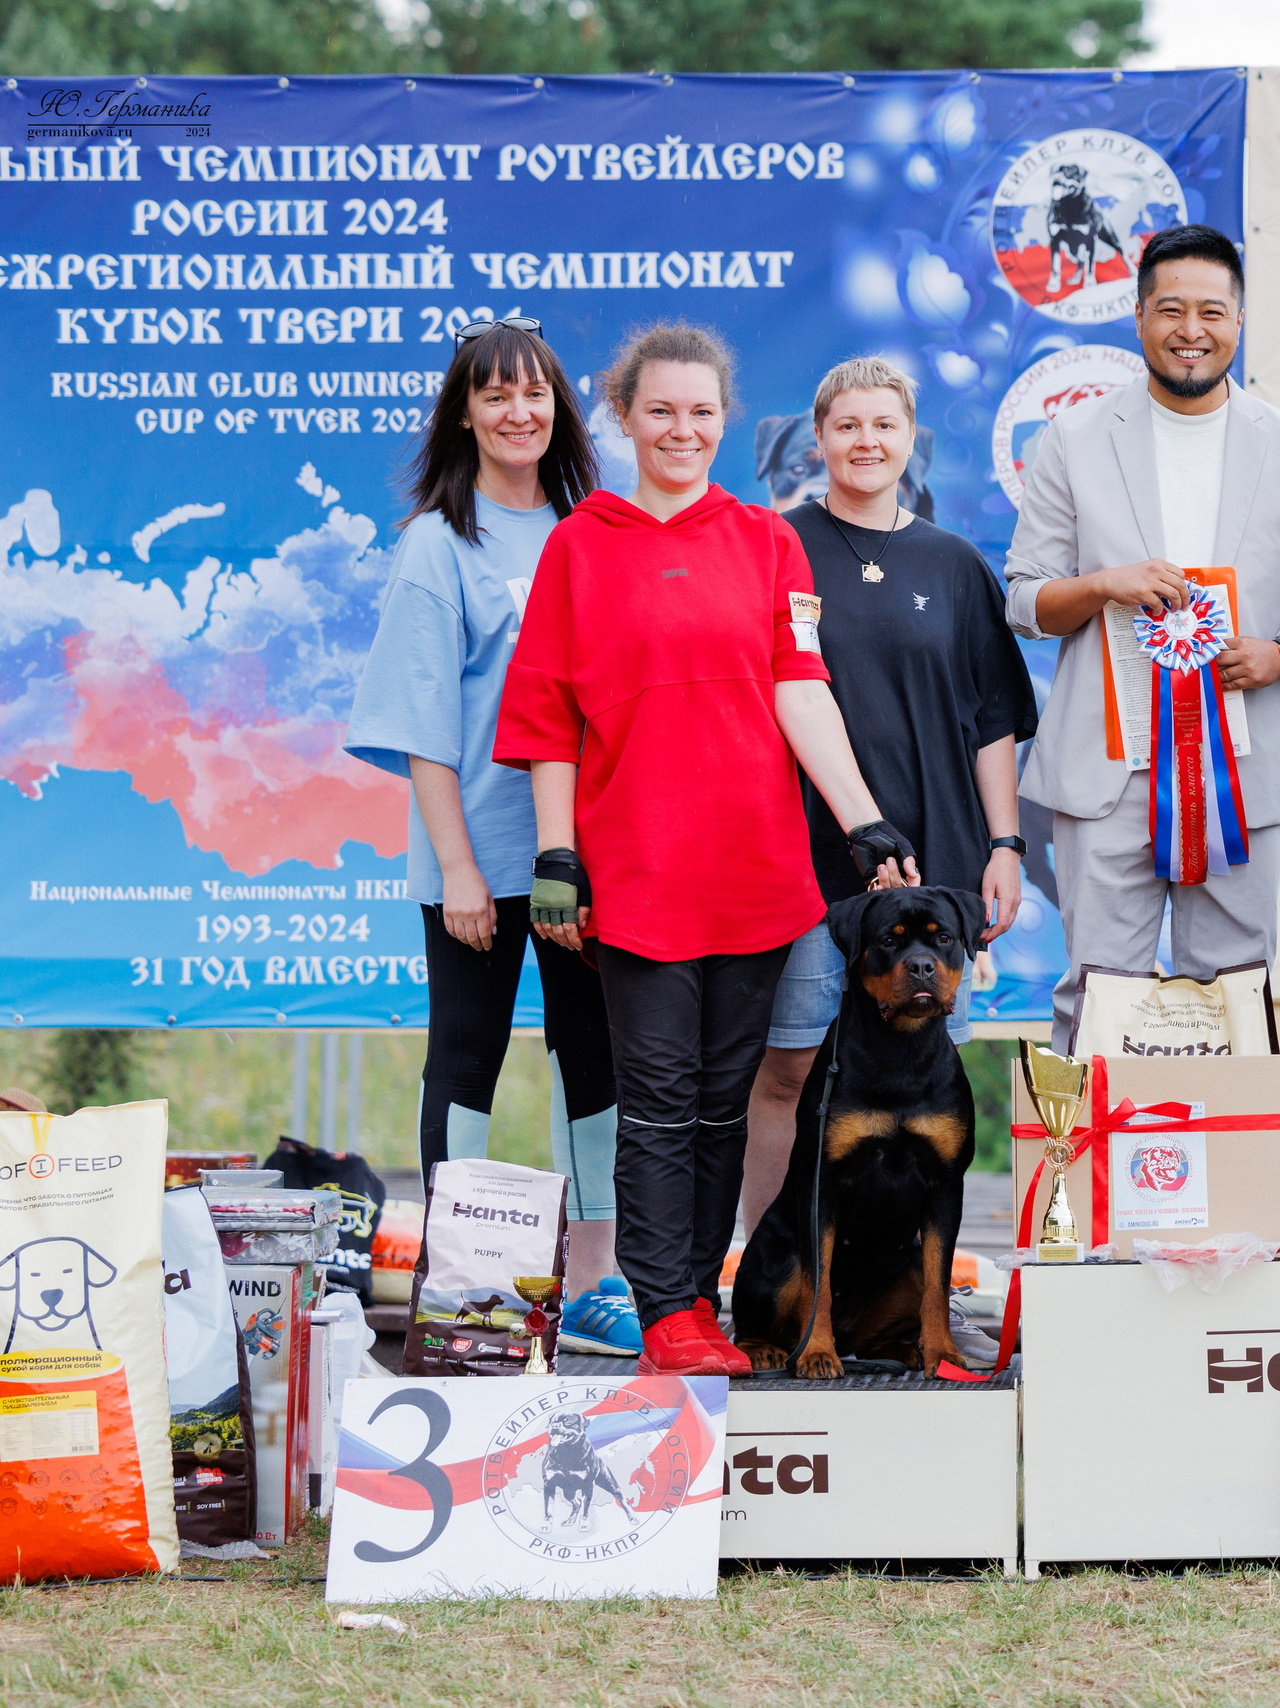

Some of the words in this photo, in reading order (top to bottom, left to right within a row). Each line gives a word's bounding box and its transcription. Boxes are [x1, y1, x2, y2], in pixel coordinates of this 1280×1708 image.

[159, 142, 481, 182] ЧЕМПИОНАТ
[497, 134, 846, 182] РОТВЕЙЛЕРОВ
[131, 198, 328, 237] РОССИИ
[342, 197, 448, 236] 2024
[470, 250, 794, 289] ЧЕМПИОНАТ
[57, 306, 224, 344] КУБОК
[238, 306, 403, 344] ТВЕРИ
[420, 305, 521, 343] 20
[1052, 348, 1092, 371] 2024
[51, 371, 198, 399] RUSSIAN
[207, 371, 299, 398] CLUB
[307, 371, 445, 398] WINNER
[135, 408, 205, 434] CUP
[214, 408, 259, 434] OF
[268, 407, 362, 434] TVER
[371, 407, 435, 434] 202
[1186, 755, 1197, 797] класса
[30, 880, 194, 904] Национальные
[201, 879, 347, 901] Чемпионаты
[196, 913, 371, 944] 1993-2024
[129, 956, 165, 986] 31
[179, 954, 252, 991] ГОД
[451, 1201, 541, 1228] Hanta
[476, 1222, 511, 1231] premium
[474, 1247, 504, 1259] PUPPY
[0, 1353, 102, 1365] полнорационный
[1, 1365, 28, 1373] сухой
[73, 1361, 101, 1369] собак
[485, 1389, 570, 1516] РОТВЕЙЛЕР
[585, 1387, 652, 1416] КЛУБ
[656, 1418, 688, 1515] РОССИИ
[353, 1387, 453, 1562] 3
[528, 1530, 641, 1561] РКФ-НКПР
